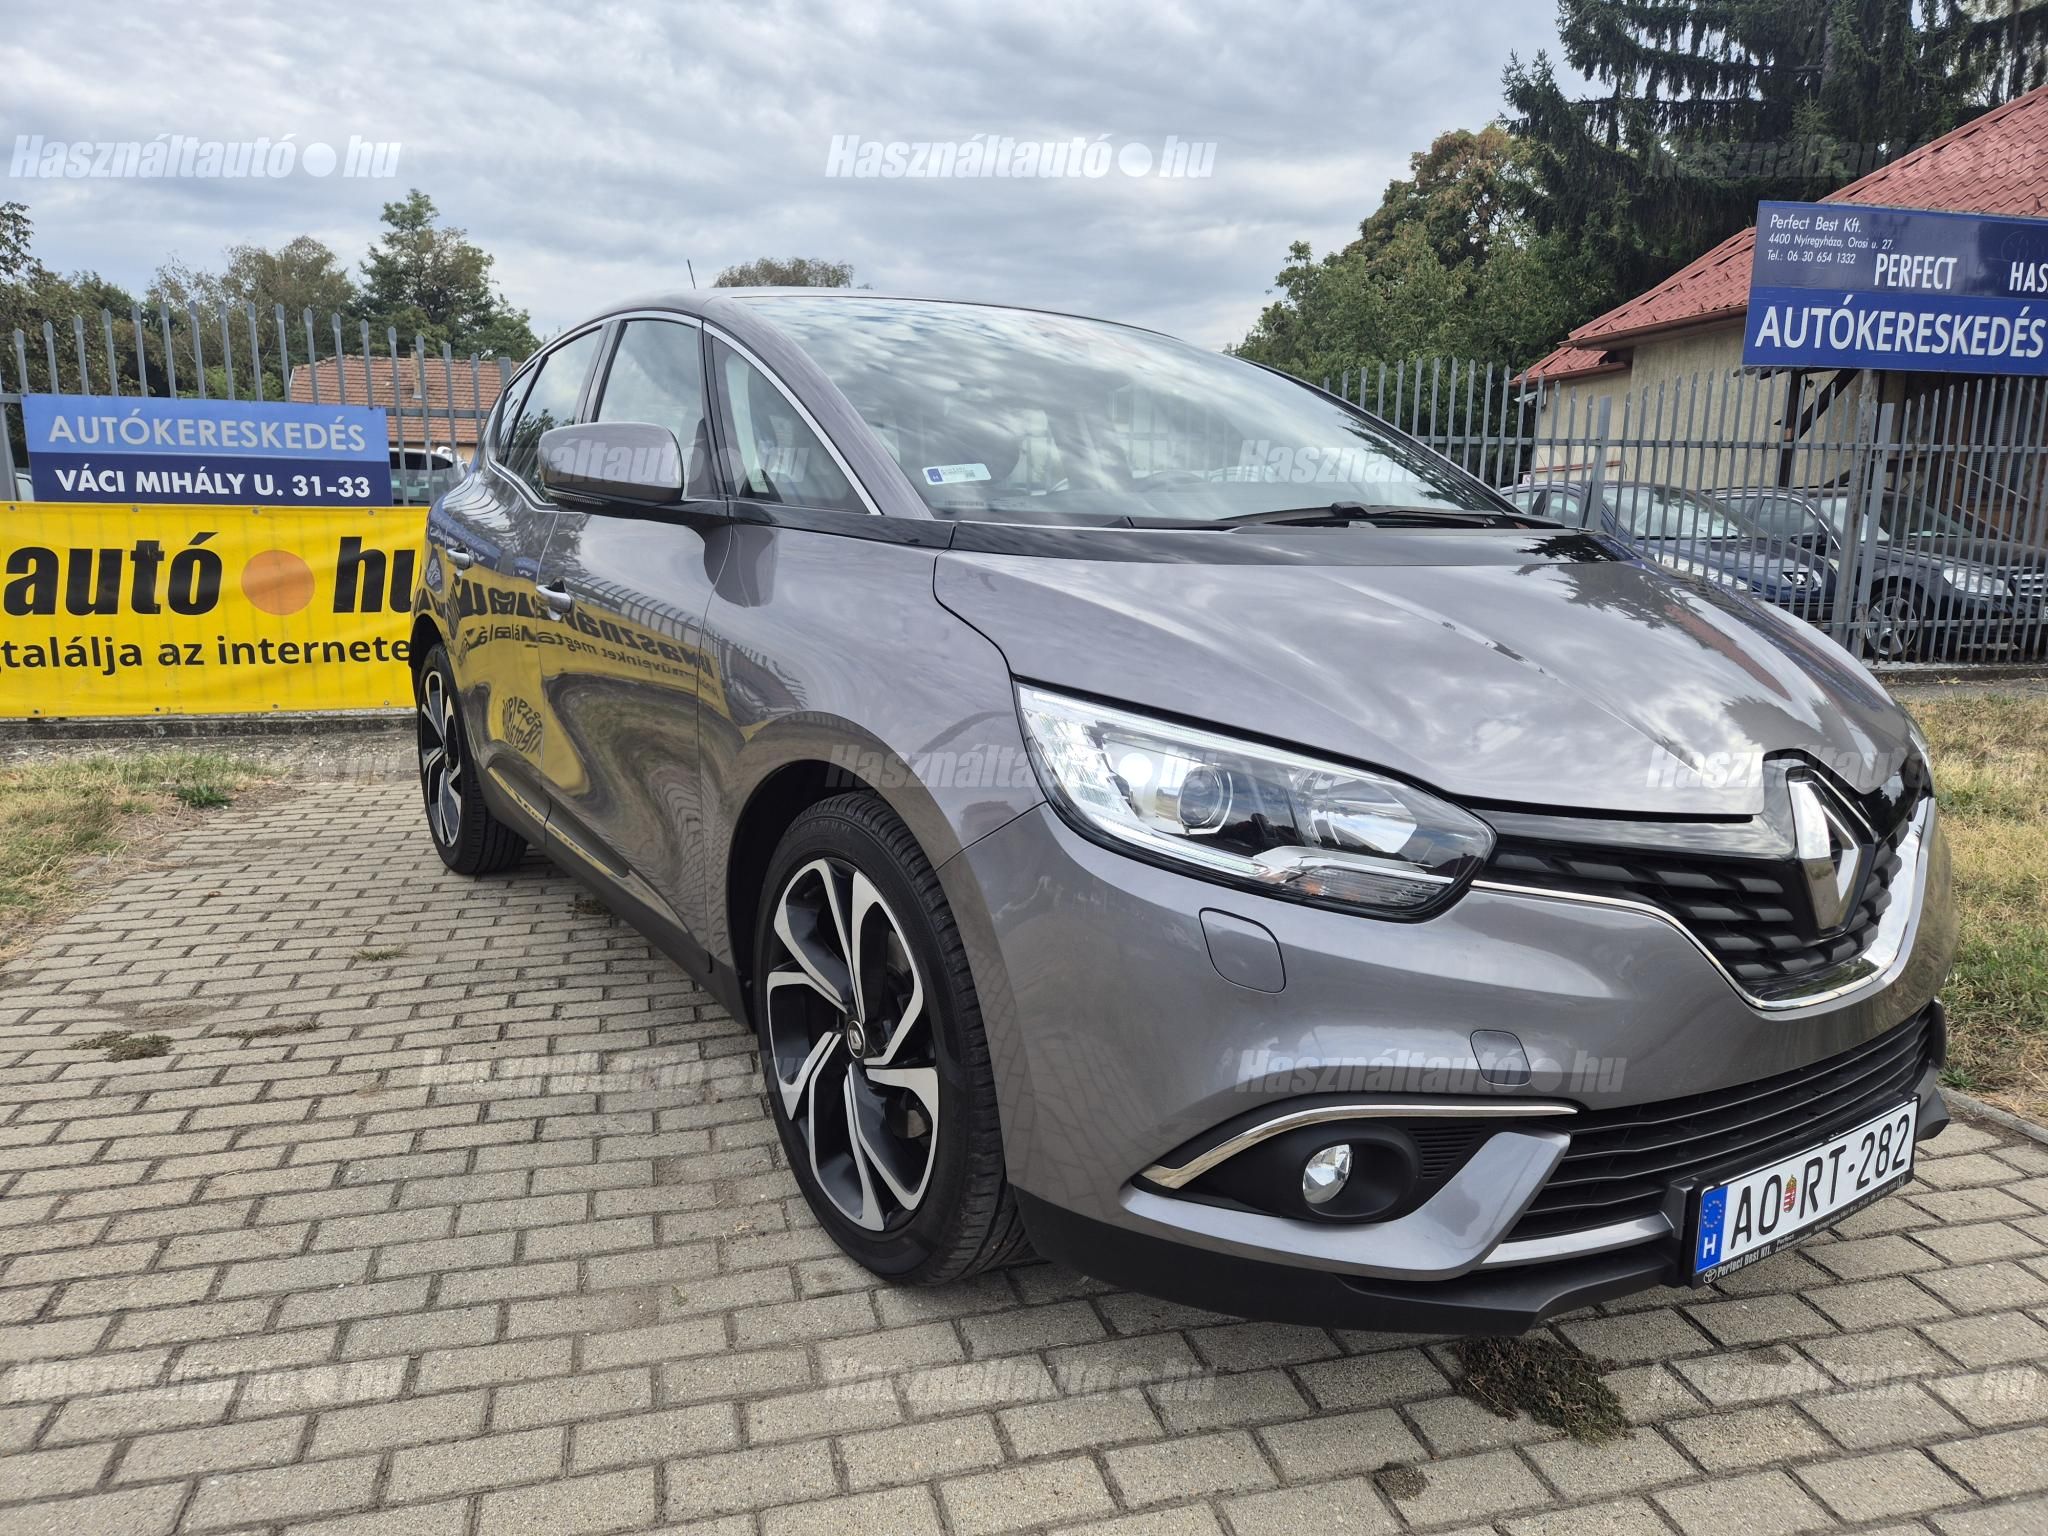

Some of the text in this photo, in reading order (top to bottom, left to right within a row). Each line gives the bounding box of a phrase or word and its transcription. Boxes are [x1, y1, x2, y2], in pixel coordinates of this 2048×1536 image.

[1770, 214, 1862, 233] Perfect Best Kft.
[1767, 250, 1856, 264] Tel.: 06 30 654 1332
[1768, 234, 1791, 245] 4400
[1794, 234, 1844, 248] Nyíregyháza,
[1848, 237, 1869, 249] Orosi
[1882, 239, 1894, 250] 27.
[1873, 253, 1957, 290] PERFECT
[1755, 295, 2047, 358] AUTÓKERESKEDÉS
[49, 408, 366, 451] AUTÓKERESKEDÉS
[55, 463, 371, 498] VÁCI MIHÁLY U. 31-33
[0, 636, 142, 676] találja
[158, 643, 204, 666] az
[1730, 1174, 1782, 1250] AO
[1703, 1233, 1717, 1259] H
